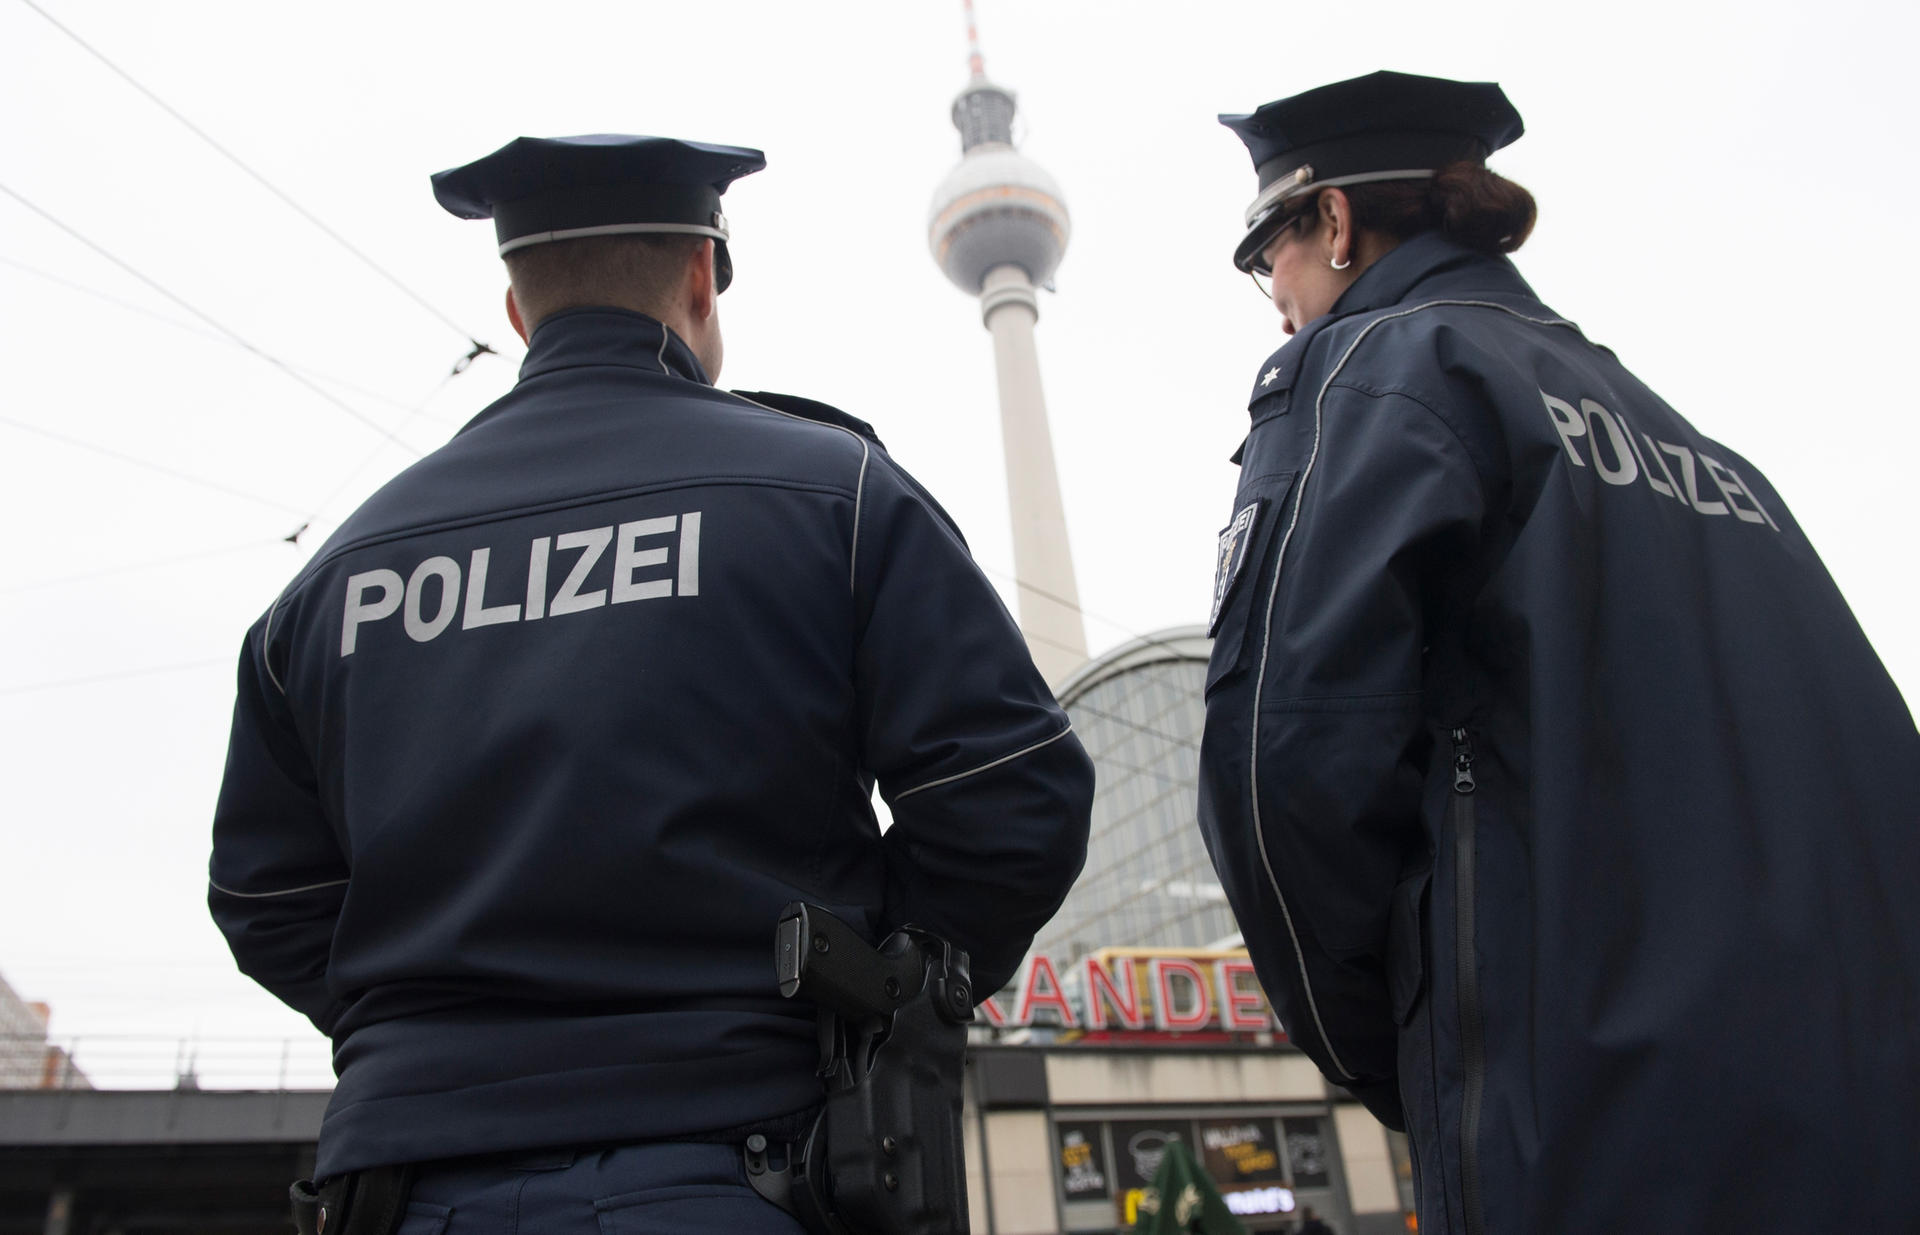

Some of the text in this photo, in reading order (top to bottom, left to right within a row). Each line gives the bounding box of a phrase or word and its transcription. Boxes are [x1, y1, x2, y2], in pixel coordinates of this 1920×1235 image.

[1538, 386, 1780, 532] POLIZEI
[340, 511, 702, 658] POLIZEI
[982, 955, 1284, 1031] ANDE
